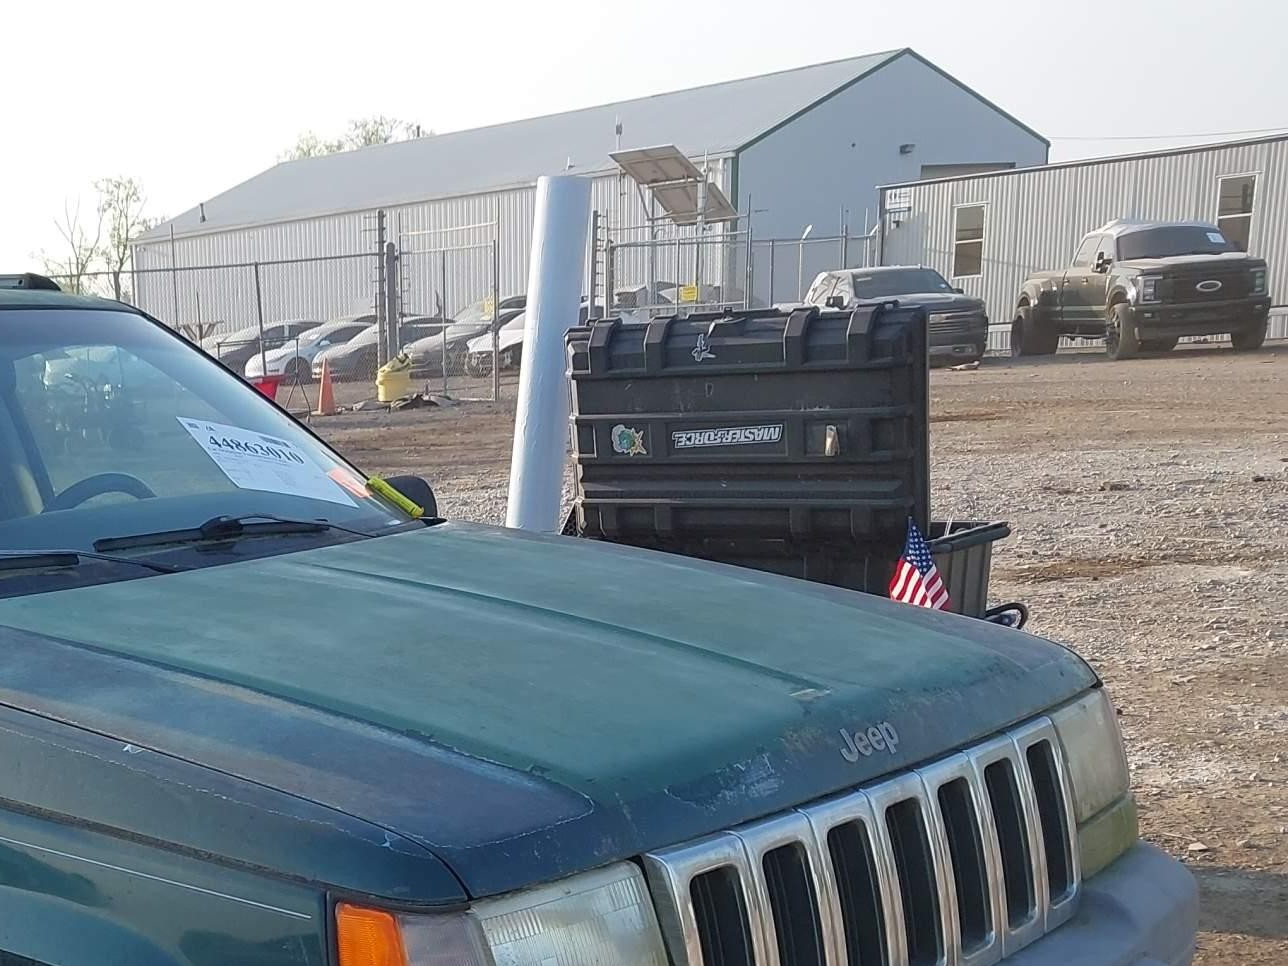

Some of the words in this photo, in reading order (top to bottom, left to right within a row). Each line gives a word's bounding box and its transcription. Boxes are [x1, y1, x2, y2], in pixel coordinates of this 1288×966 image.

[209, 435, 305, 465] 44863010
[675, 426, 781, 446] MASTERFORCE
[839, 721, 899, 762] Jeep
